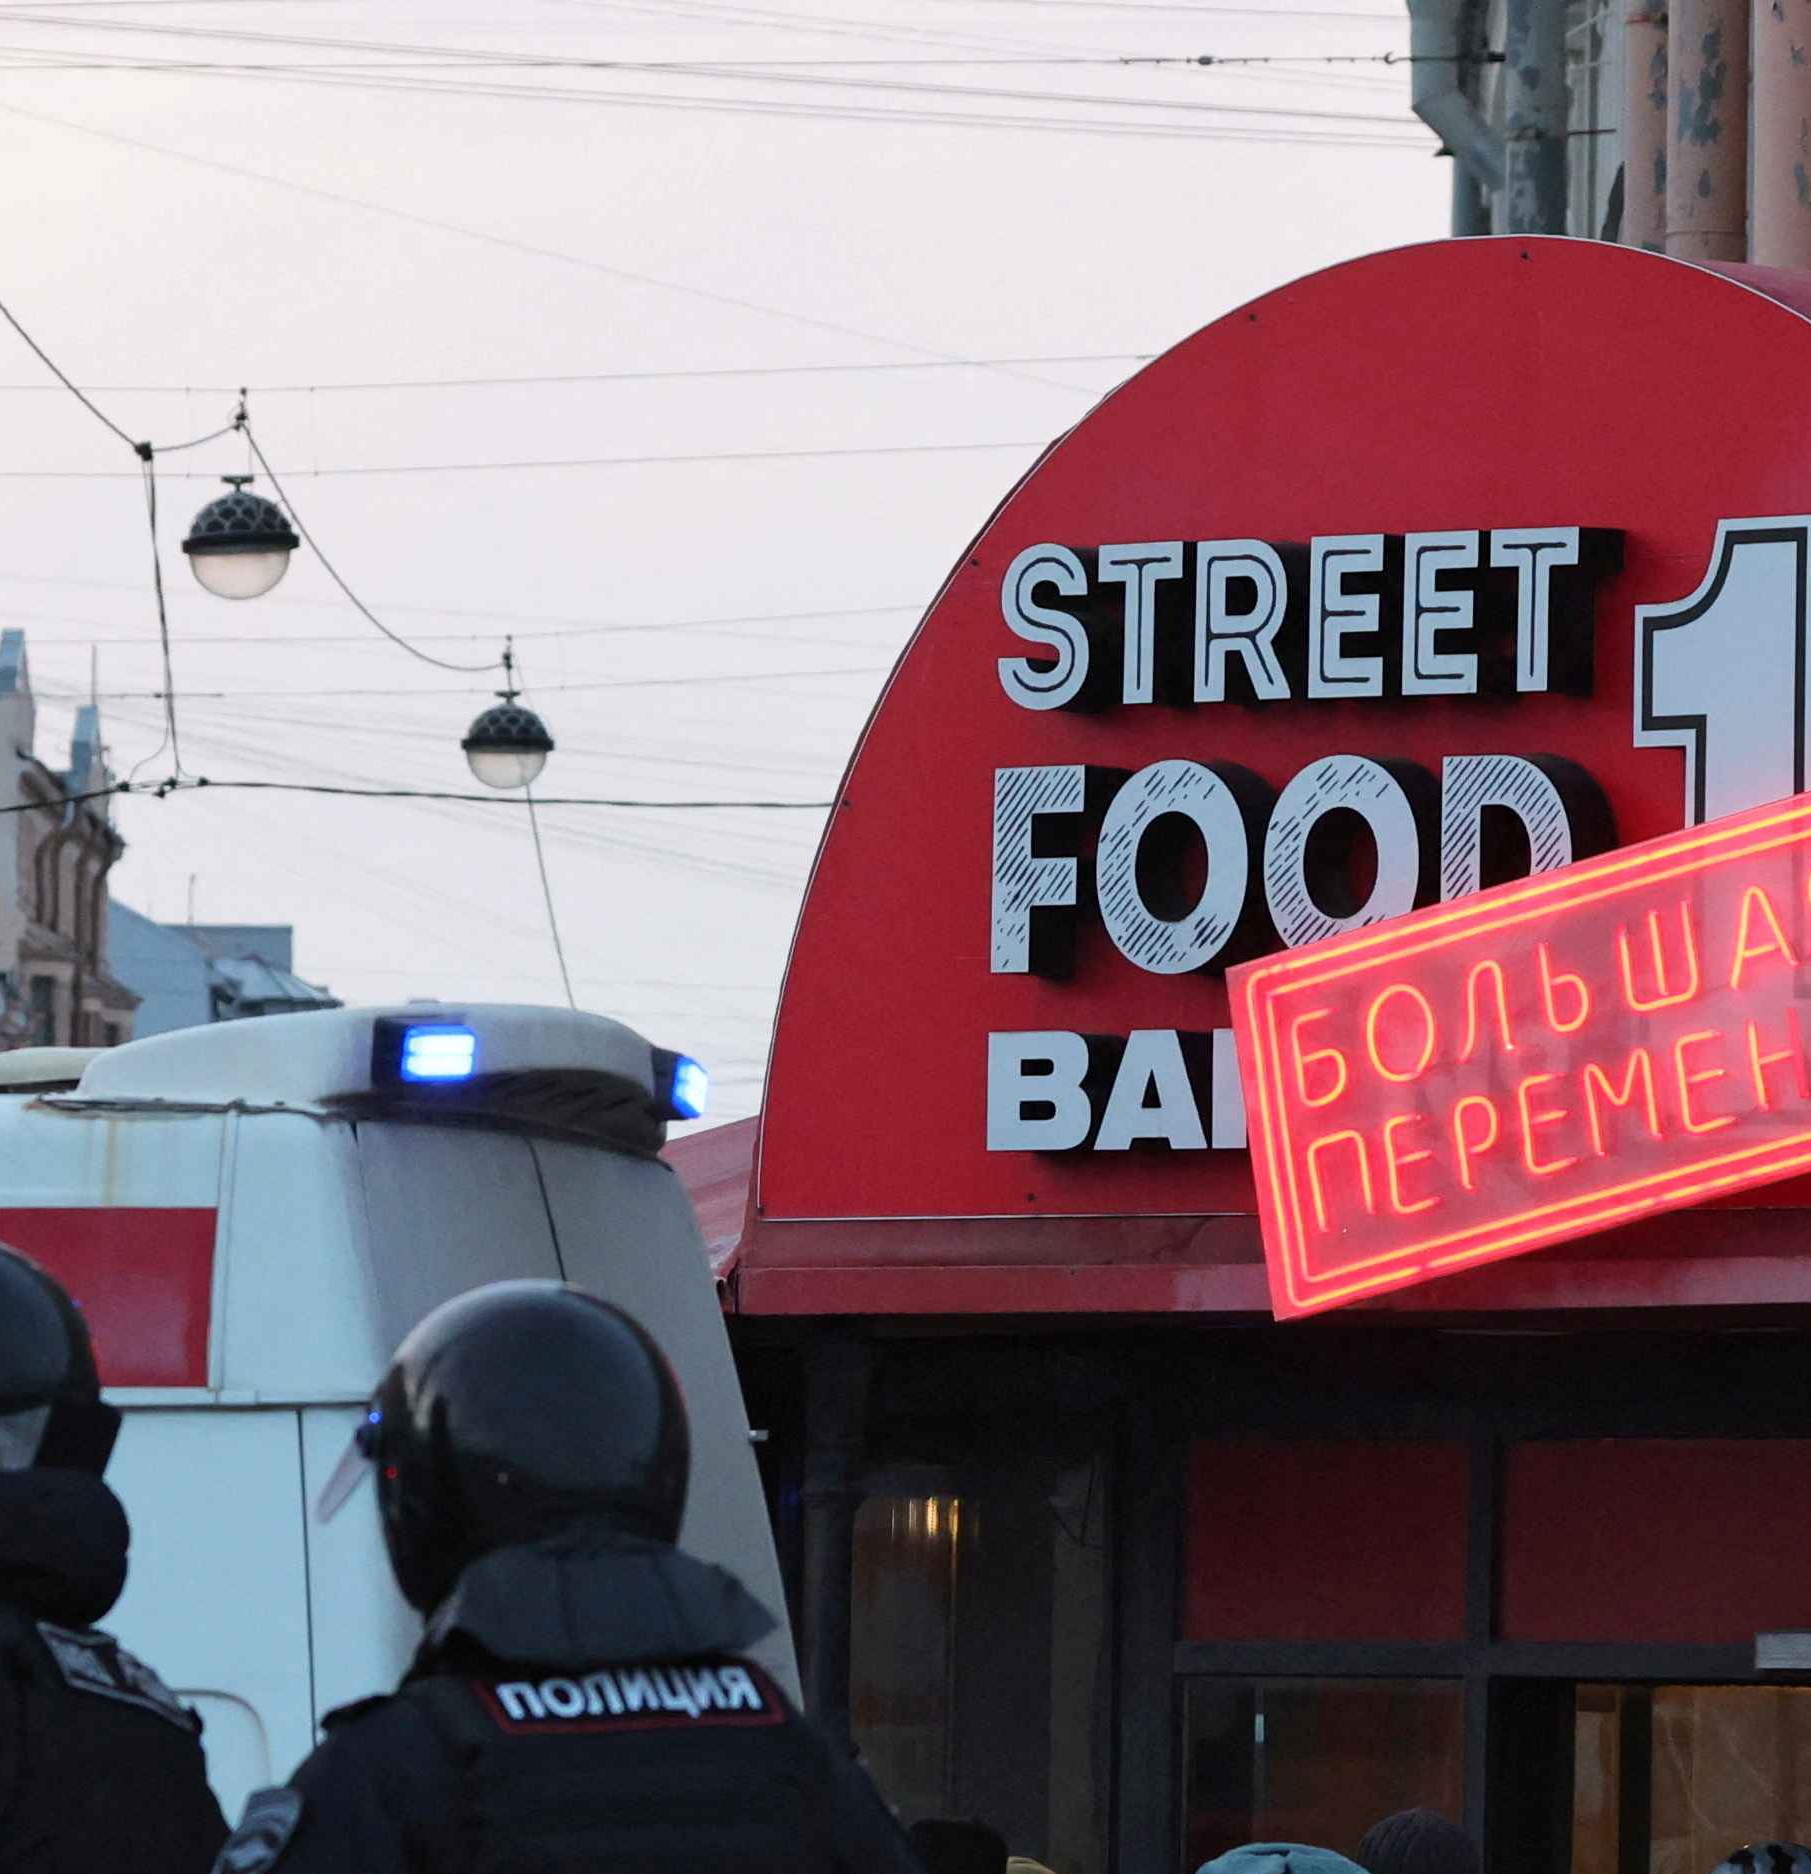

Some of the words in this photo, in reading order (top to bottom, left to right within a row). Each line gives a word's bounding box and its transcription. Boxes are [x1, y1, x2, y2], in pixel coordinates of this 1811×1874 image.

[996, 526, 1581, 711] STREET
[990, 754, 1574, 976] FOOD
[987, 1028, 1248, 1153] BA
[494, 1664, 764, 1720] ПОЛИЦИЯ
